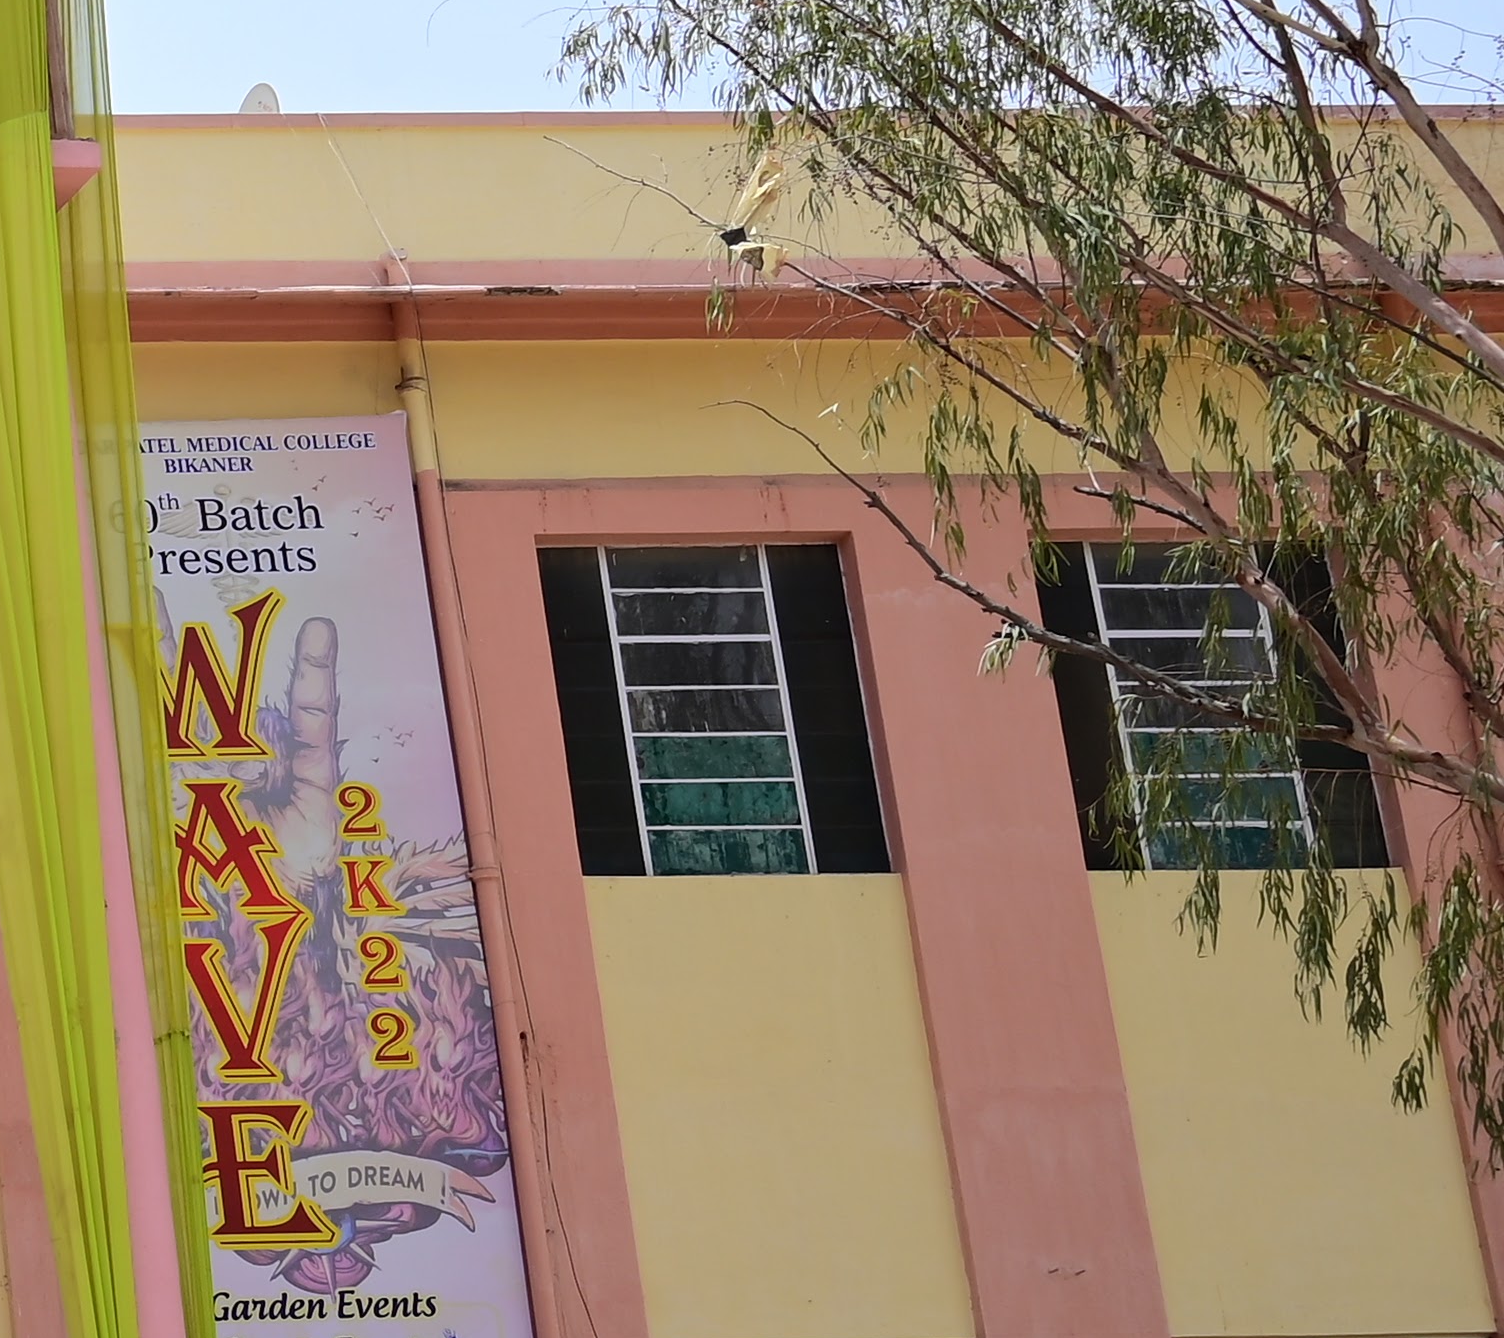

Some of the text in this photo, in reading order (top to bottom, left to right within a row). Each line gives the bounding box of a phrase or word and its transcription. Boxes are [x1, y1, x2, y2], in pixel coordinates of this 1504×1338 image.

[187, 433, 376, 454] MEDICAL COLLEGE
[164, 457, 254, 474] BIKANER
[195, 495, 325, 532] Batch
[307, 1165, 425, 1195] TO DREAM
[213, 1288, 438, 1322] Garden Events
